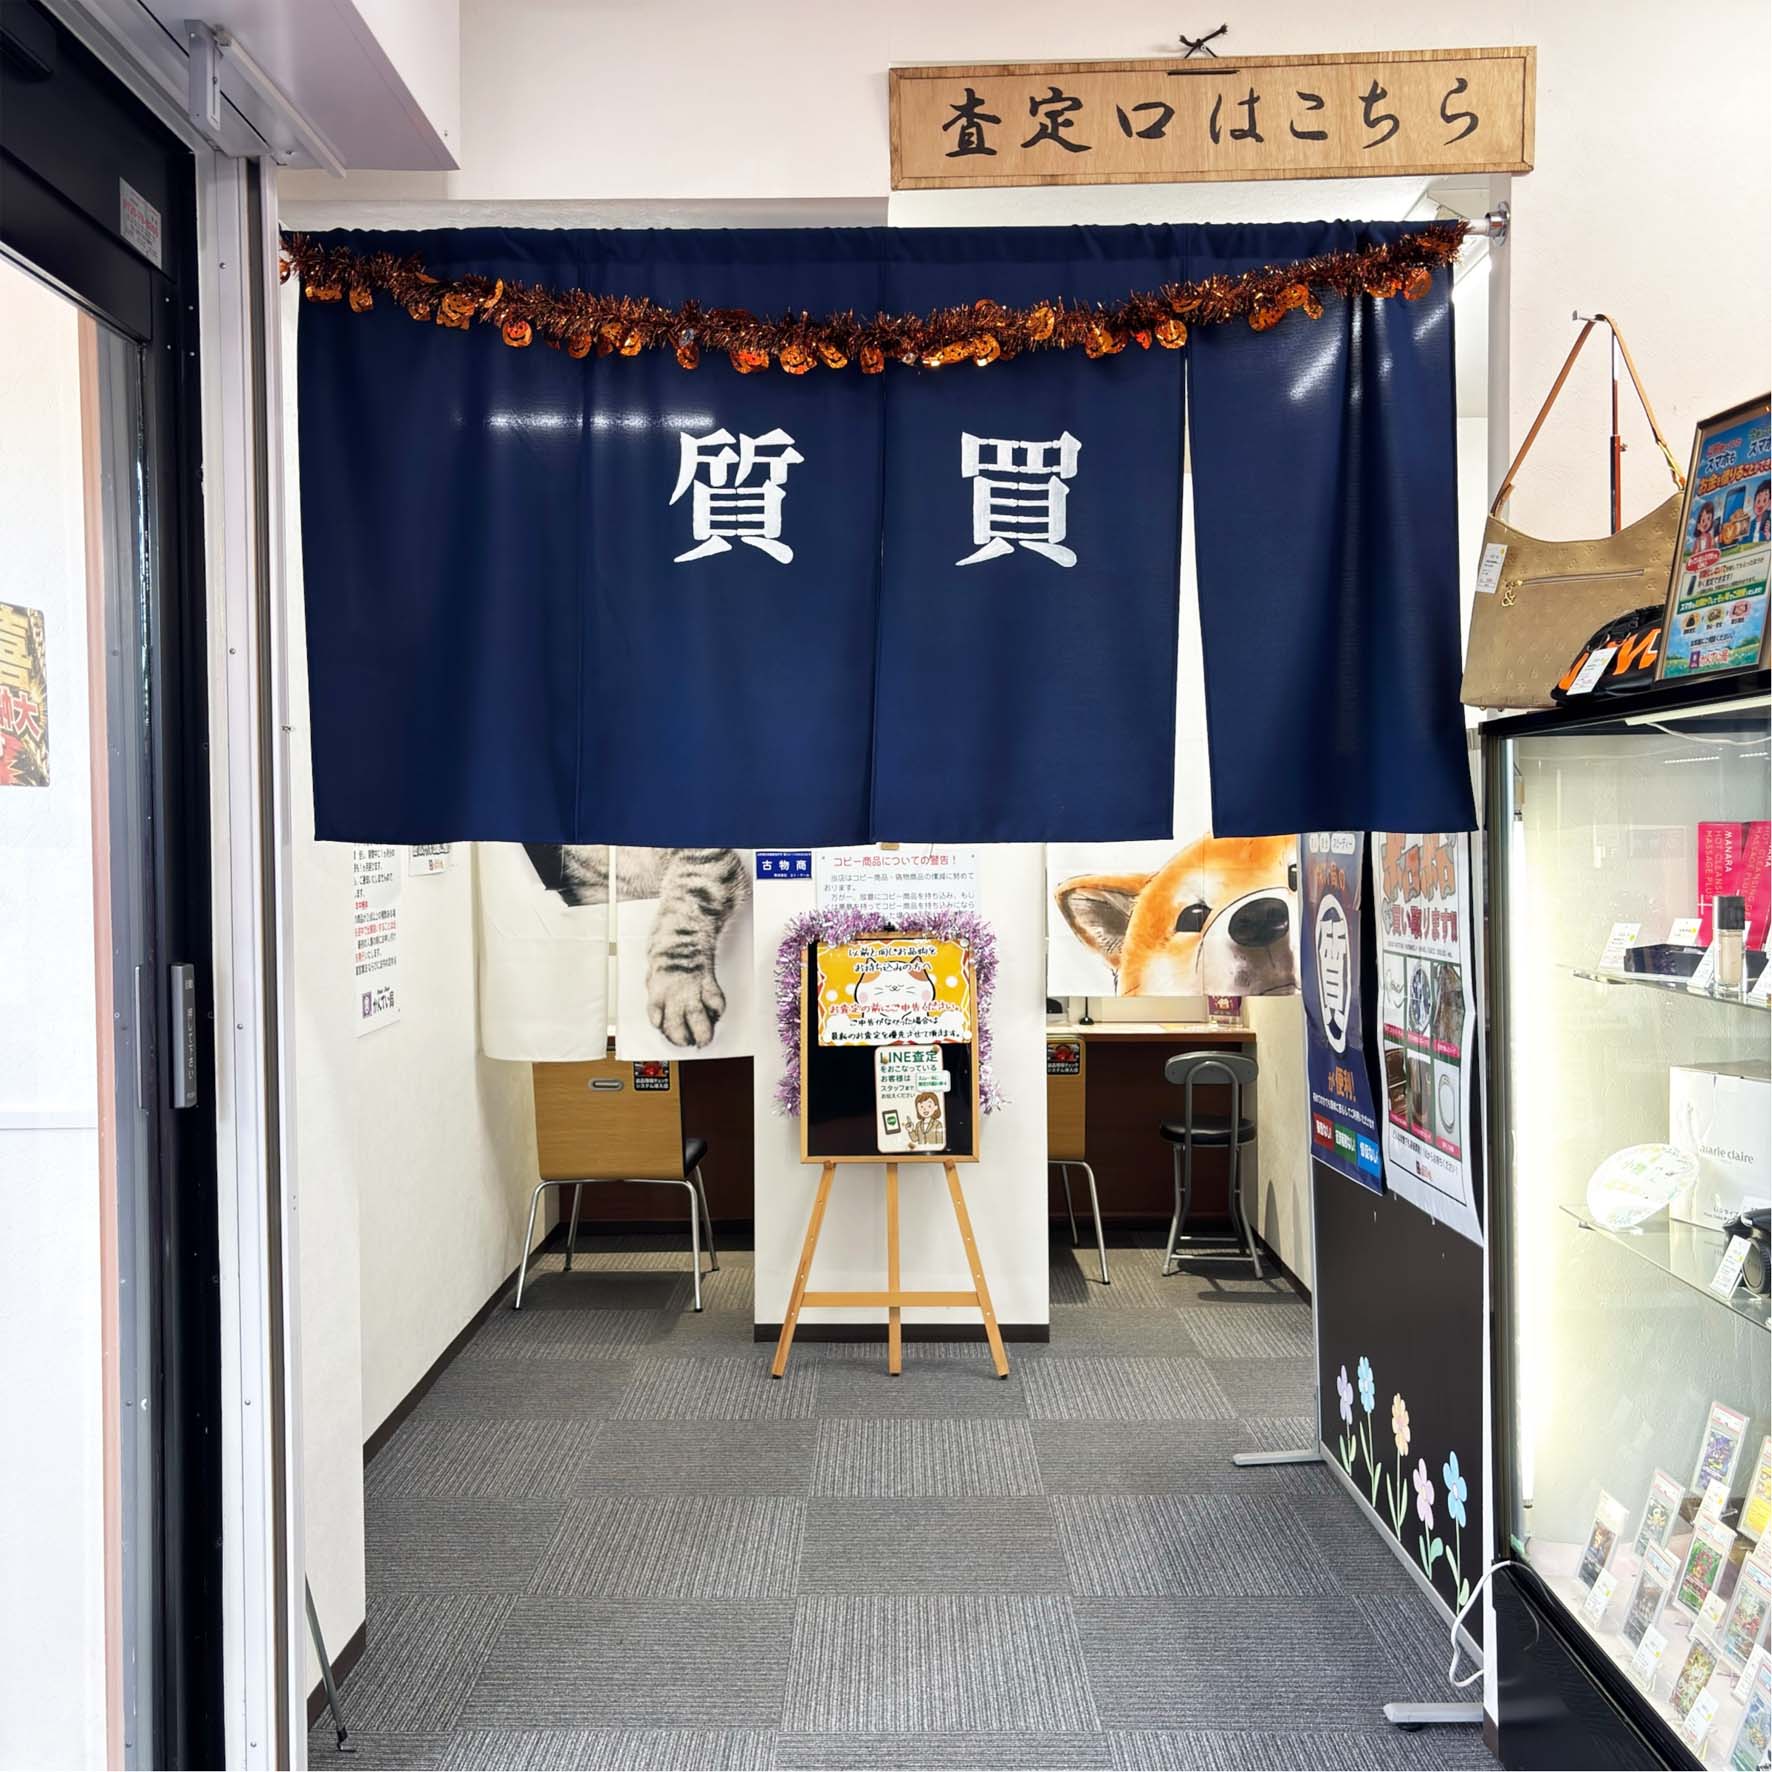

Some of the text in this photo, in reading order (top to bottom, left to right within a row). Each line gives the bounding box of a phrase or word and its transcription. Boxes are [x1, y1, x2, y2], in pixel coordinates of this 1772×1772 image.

[942, 77, 1480, 158] 査定口はこちら
[669, 428, 1083, 567] 質 買
[1725, 831, 1733, 873] MANARA
[762, 860, 807, 871] 古物商
[854, 962, 931, 973] お持ち込みの方へ
[880, 1050, 938, 1064] LINE査定
[880, 1064, 937, 1073] をおこなっている
[880, 1074, 911, 1083] お客様は
[1727, 1150, 1754, 1165] claire
